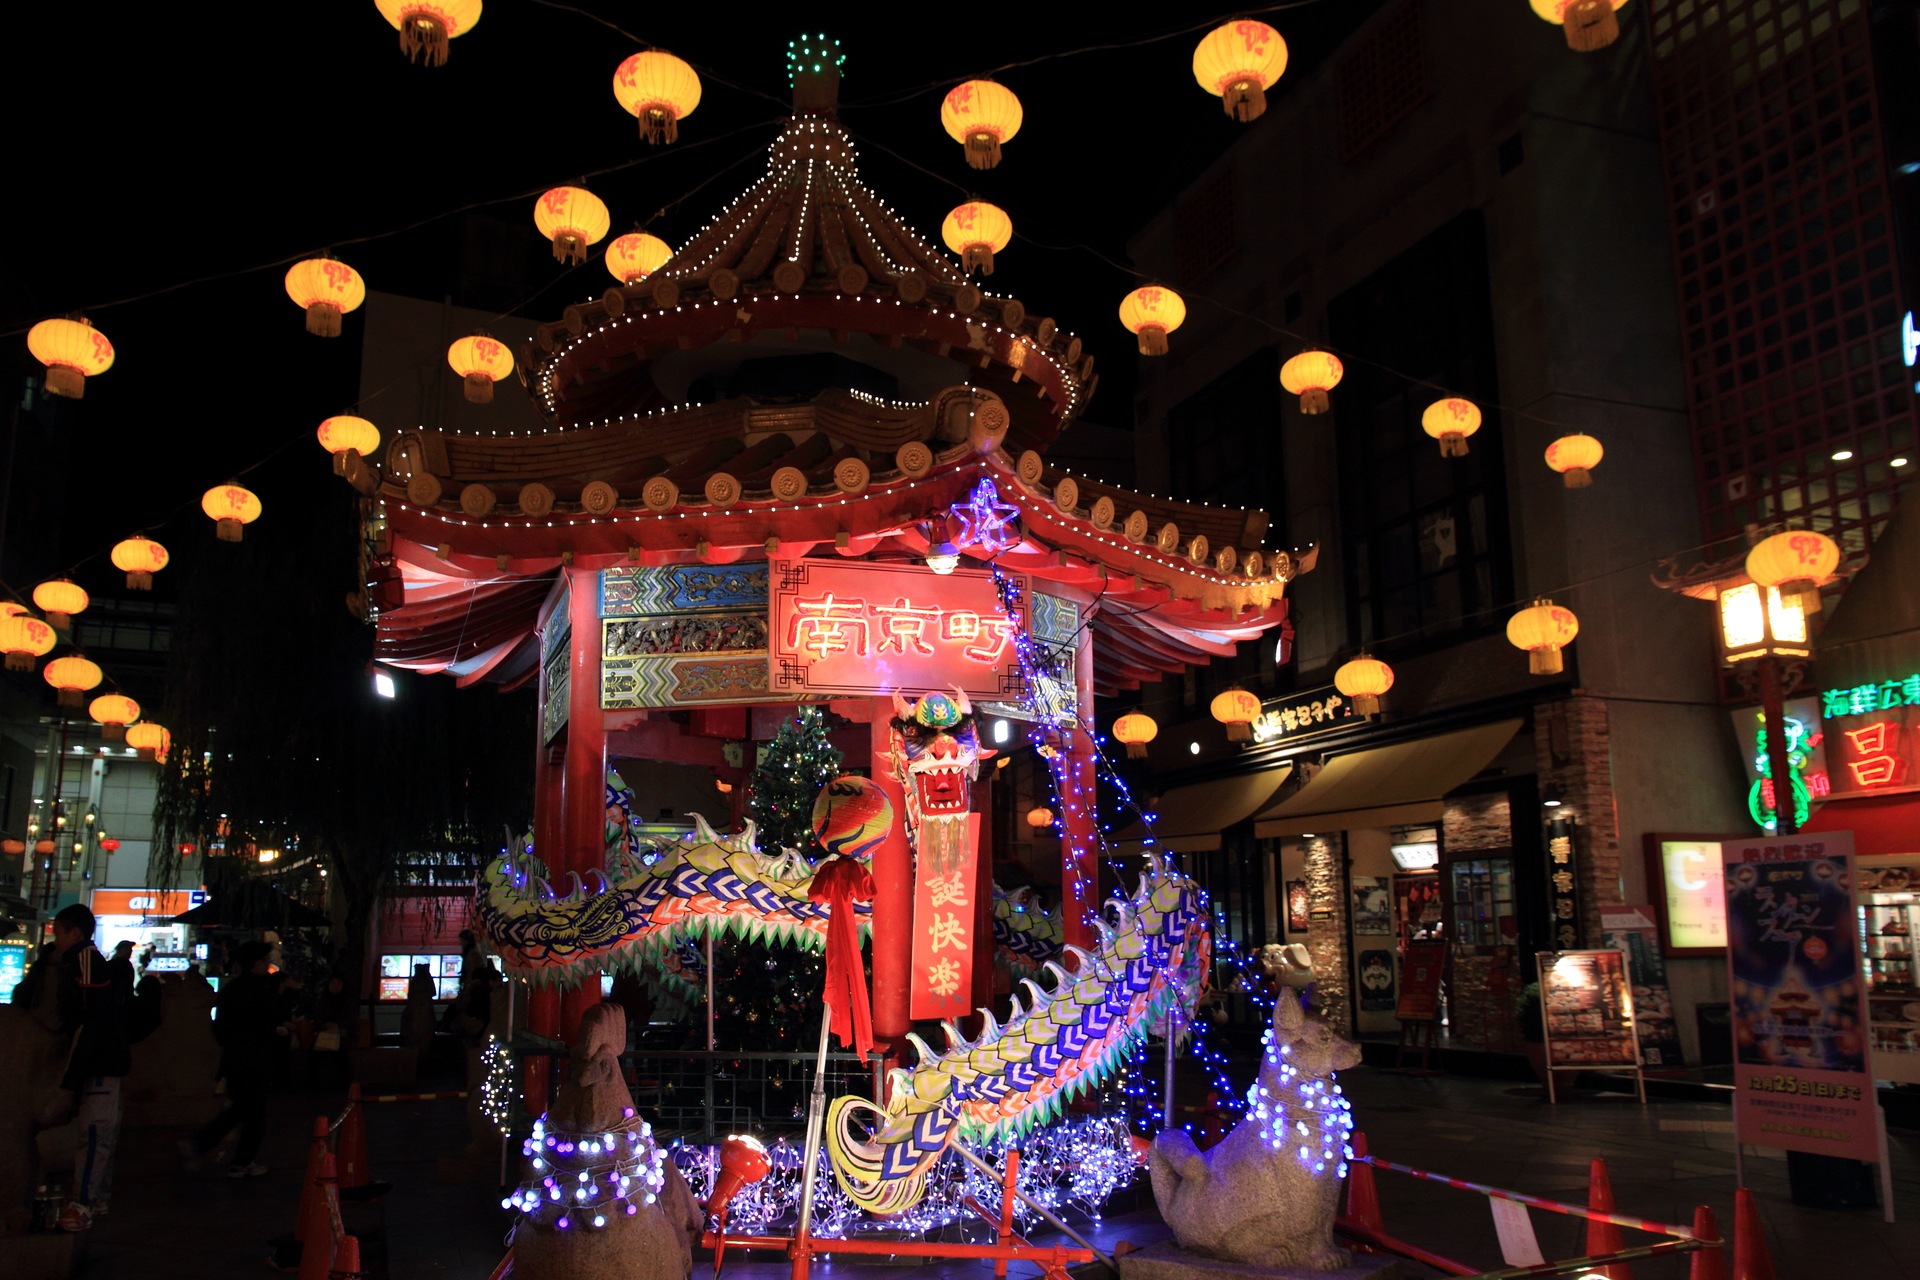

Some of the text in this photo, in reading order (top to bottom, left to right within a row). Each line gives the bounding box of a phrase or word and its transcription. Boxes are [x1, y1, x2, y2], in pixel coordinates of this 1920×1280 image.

[788, 591, 1014, 663] 南京町
[1844, 722, 1920, 787] 昌
[1669, 849, 1708, 891] C
[129, 896, 157, 910] au
[1748, 1075, 1861, 1101] 12月25日(日)まで
